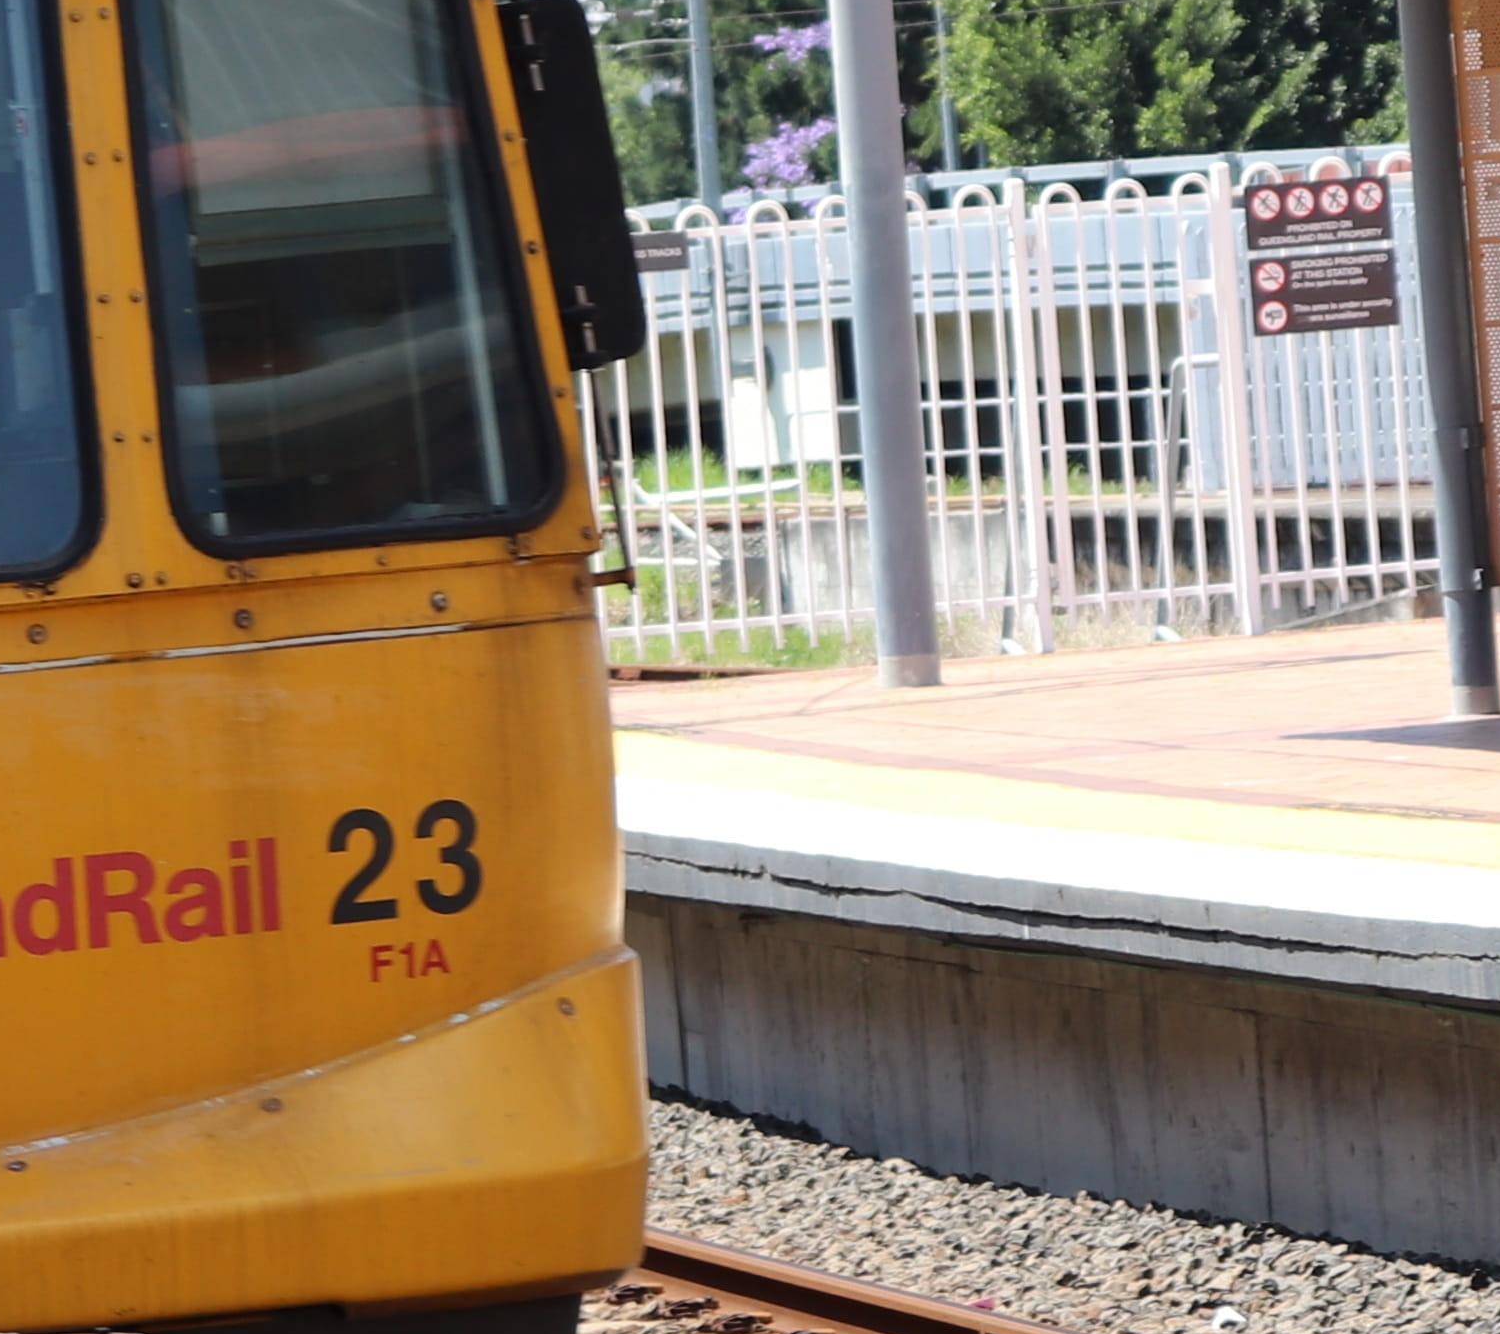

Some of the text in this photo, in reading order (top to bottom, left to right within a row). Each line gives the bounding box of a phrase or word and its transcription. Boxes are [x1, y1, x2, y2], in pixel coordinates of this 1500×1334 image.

[1286, 220, 1338, 233] PROHIBITED
[1258, 233, 1316, 246] QUEENSLAND
[1337, 228, 1383, 239] PROPERTY
[1290, 253, 1389, 269] SMOKING PROHIBITED
[1303, 268, 1325, 278] THIS
[1326, 266, 1363, 277] STATION
[325, 799, 483, 926] 23
[368, 938, 451, 983] F1A
